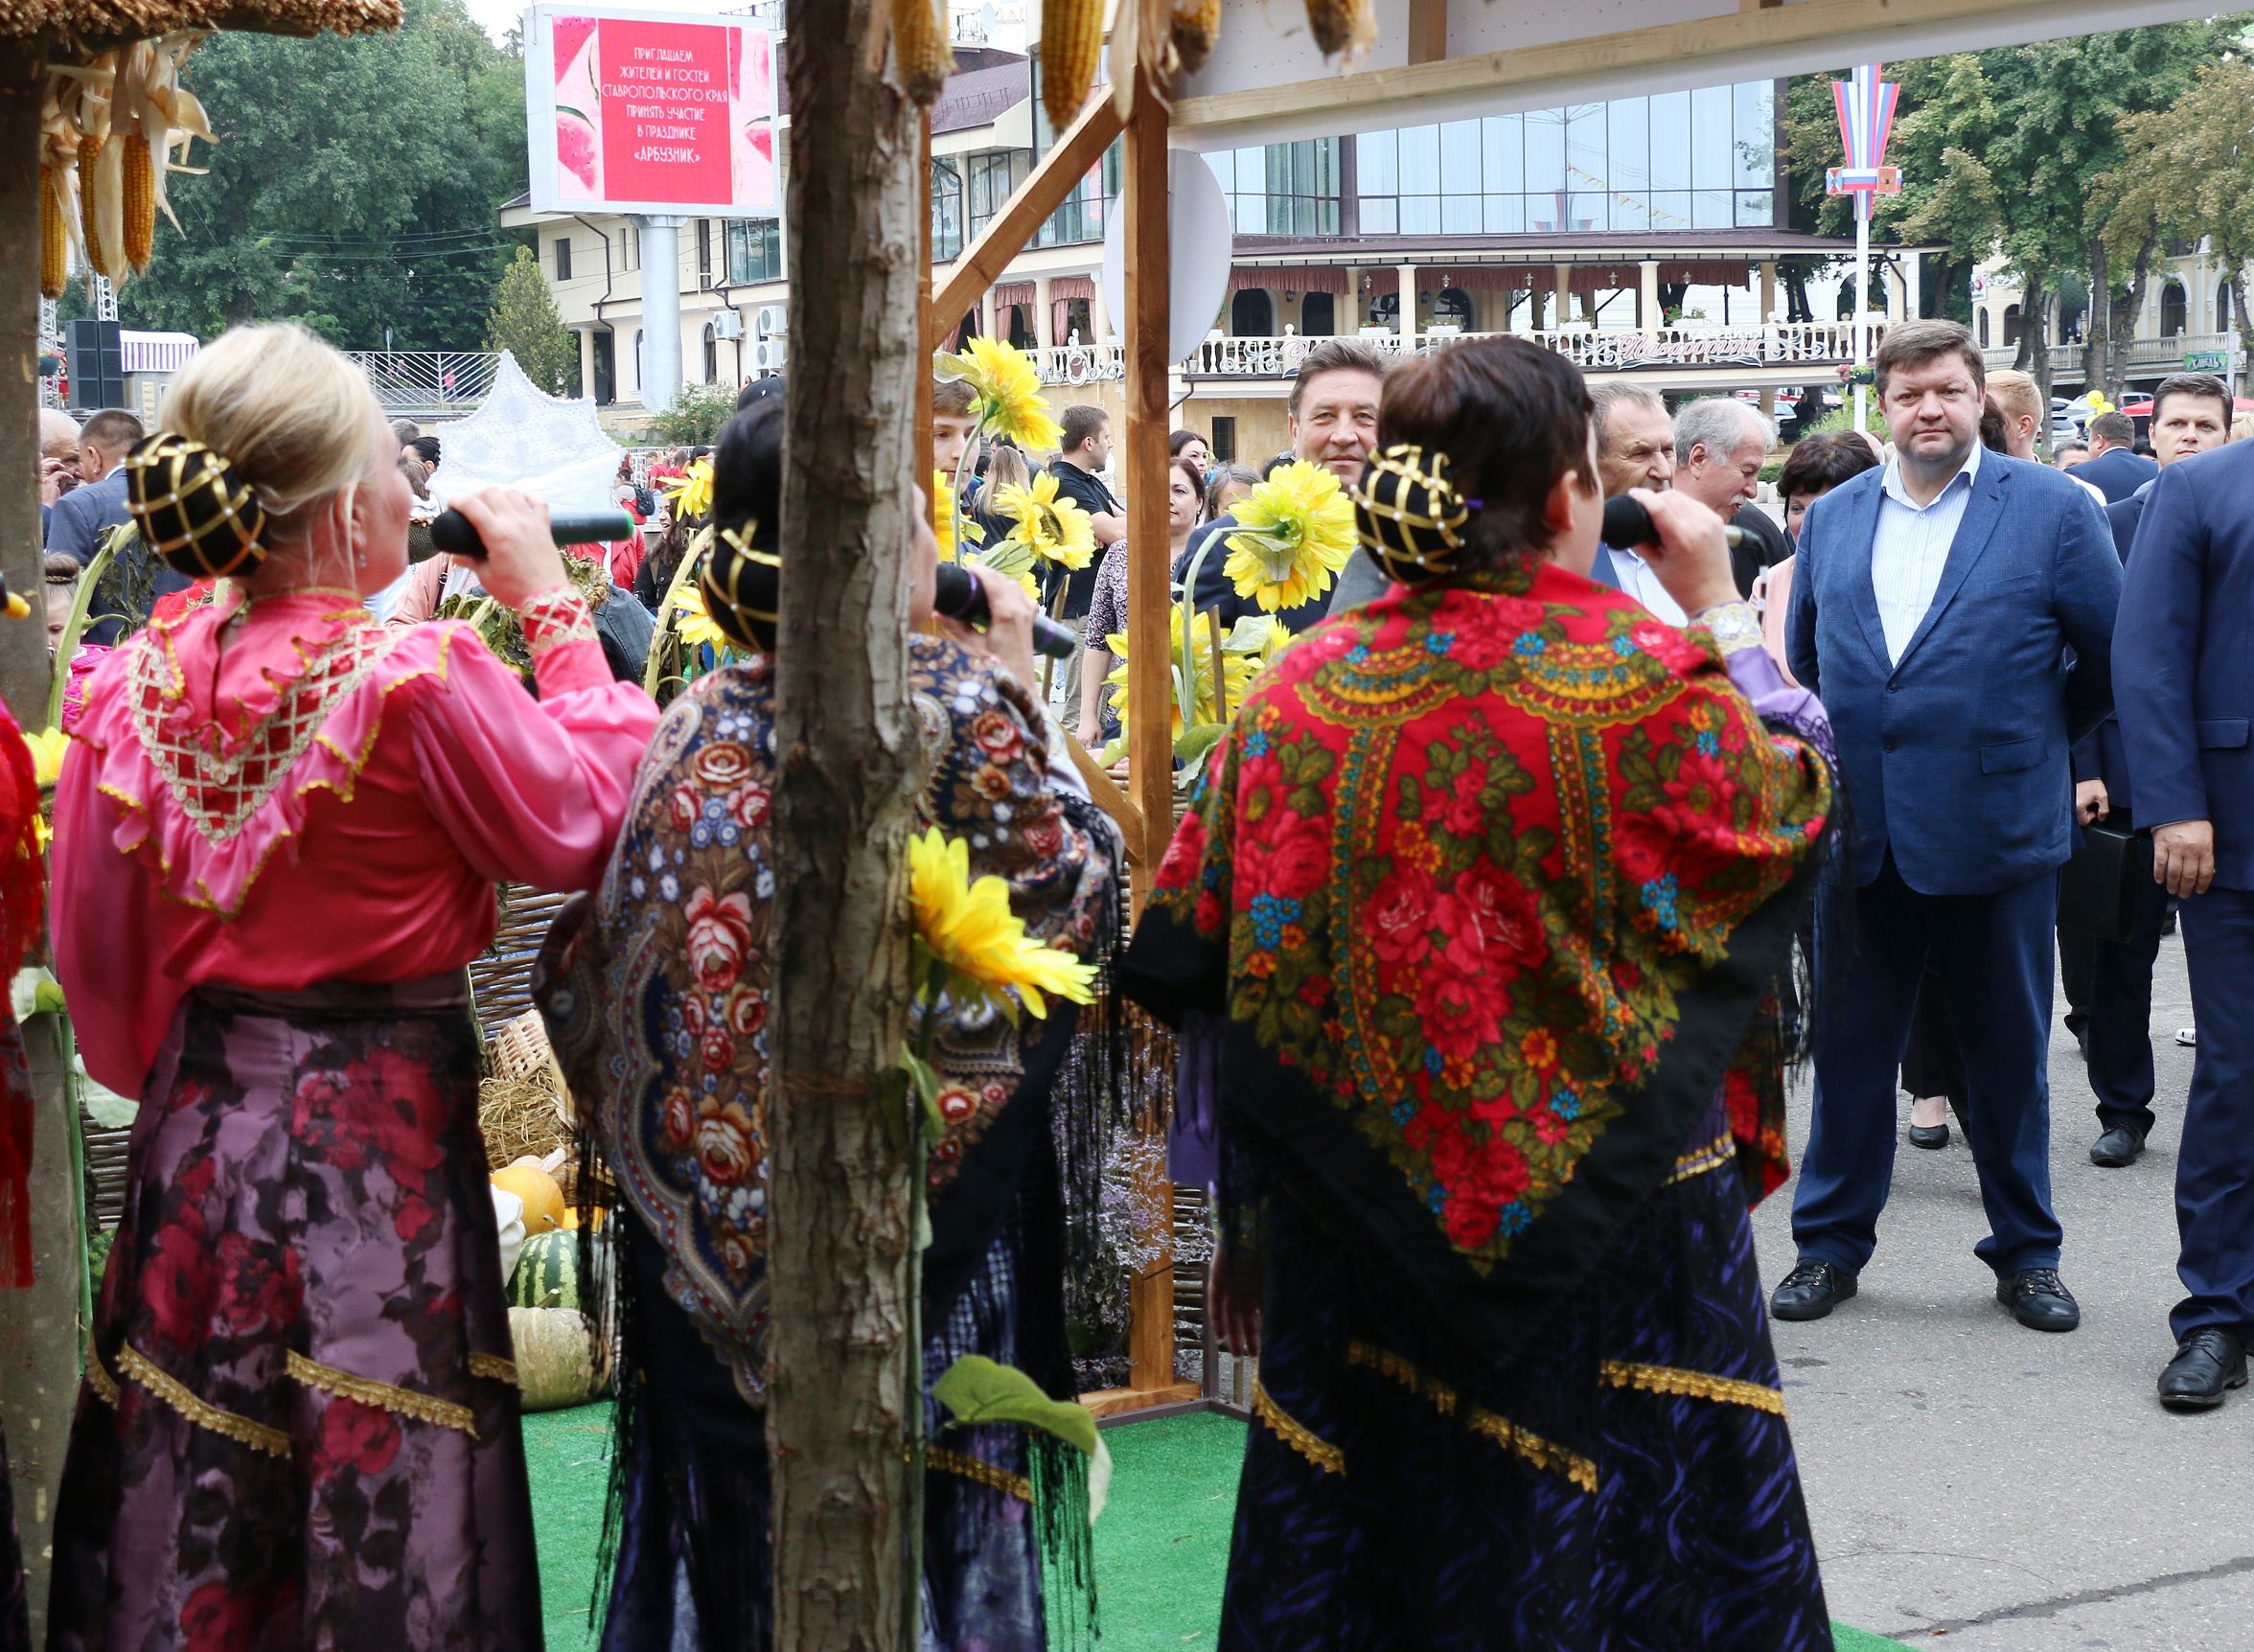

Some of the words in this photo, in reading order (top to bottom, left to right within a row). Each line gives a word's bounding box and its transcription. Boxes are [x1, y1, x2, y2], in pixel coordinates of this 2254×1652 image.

[633, 47, 694, 62] ПРИГЛАШАЕМ
[619, 65, 662, 80] ЖИТЕЛЕЙ
[665, 67, 671, 80] И
[673, 68, 709, 83] ГОСТЕЙ
[601, 83, 704, 102] СТАВРОПОЛЬСКОГО
[705, 89, 728, 103] КРАЯ
[626, 104, 665, 119] ПРИНЯТЬ
[666, 107, 705, 122] УЧАСТИЕ
[636, 125, 643, 138] В
[645, 125, 697, 141] ПРАЗДНИКЕ
[633, 146, 701, 163] «АРБУЗНИК»
